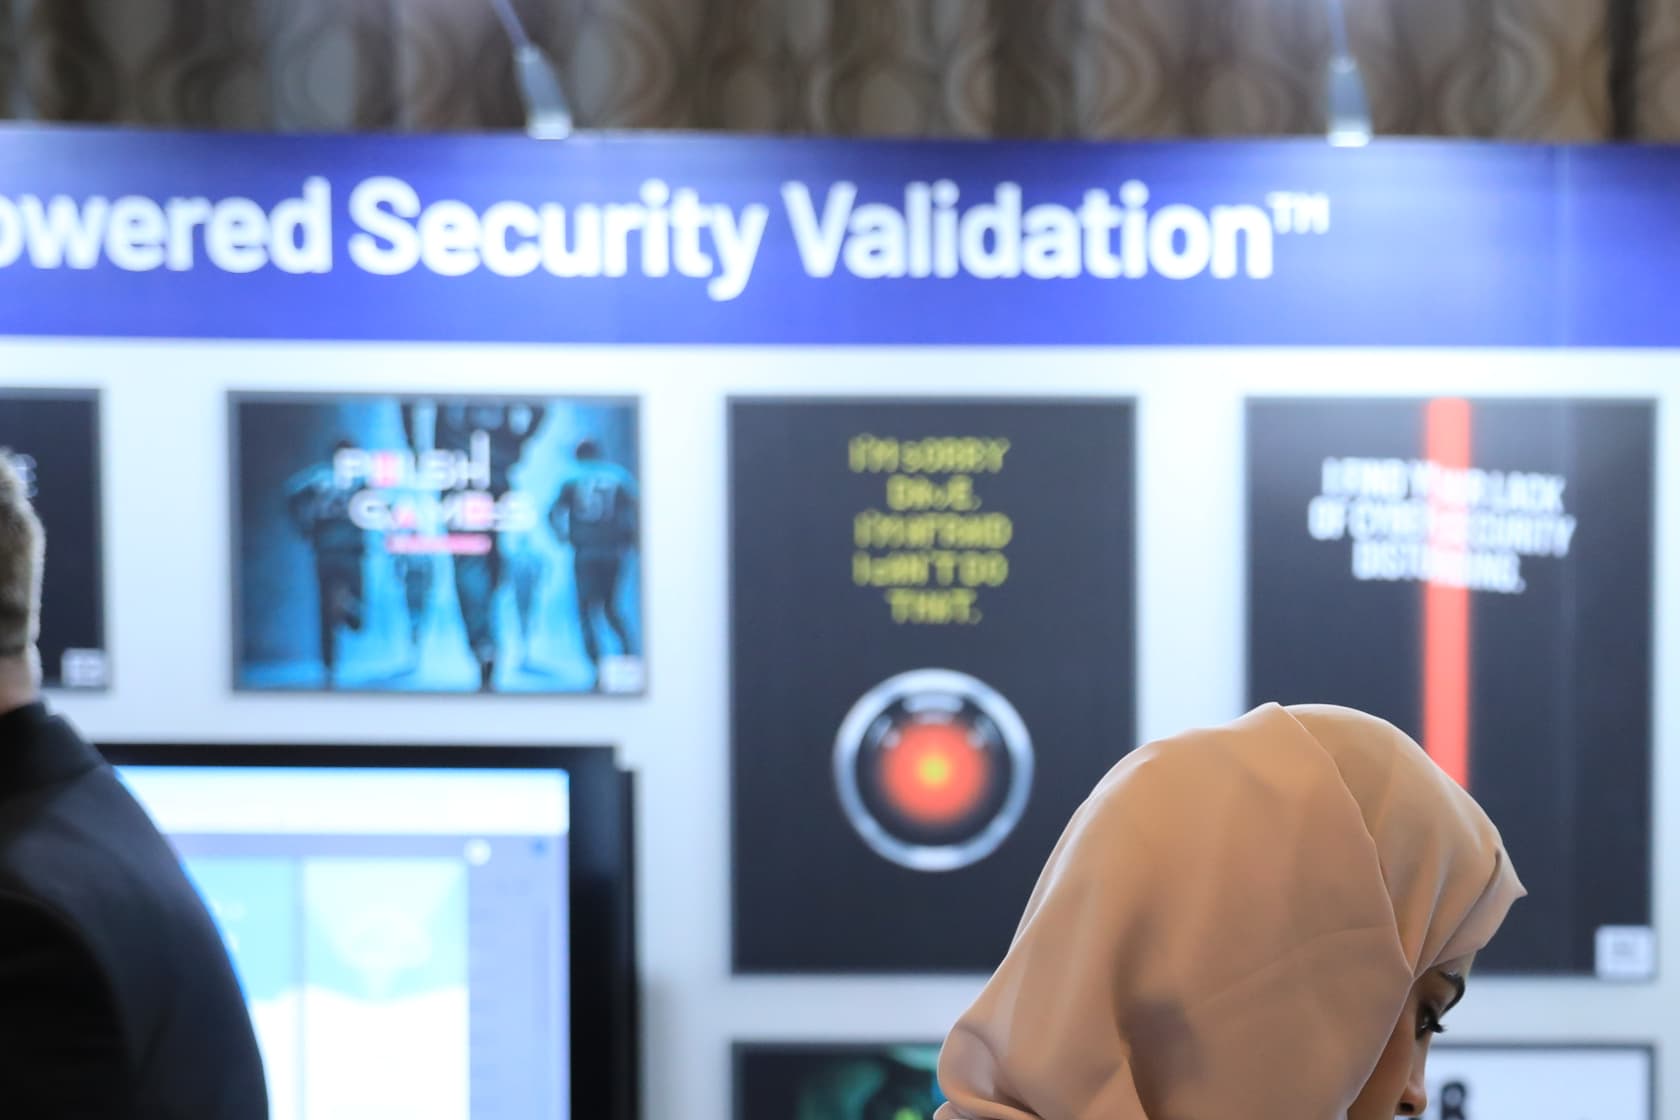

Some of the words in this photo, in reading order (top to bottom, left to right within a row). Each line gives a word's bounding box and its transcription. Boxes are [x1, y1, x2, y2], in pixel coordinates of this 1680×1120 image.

[348, 178, 769, 302] Security
[1488, 469, 1566, 513] LACK
[1308, 495, 1346, 540] OF
